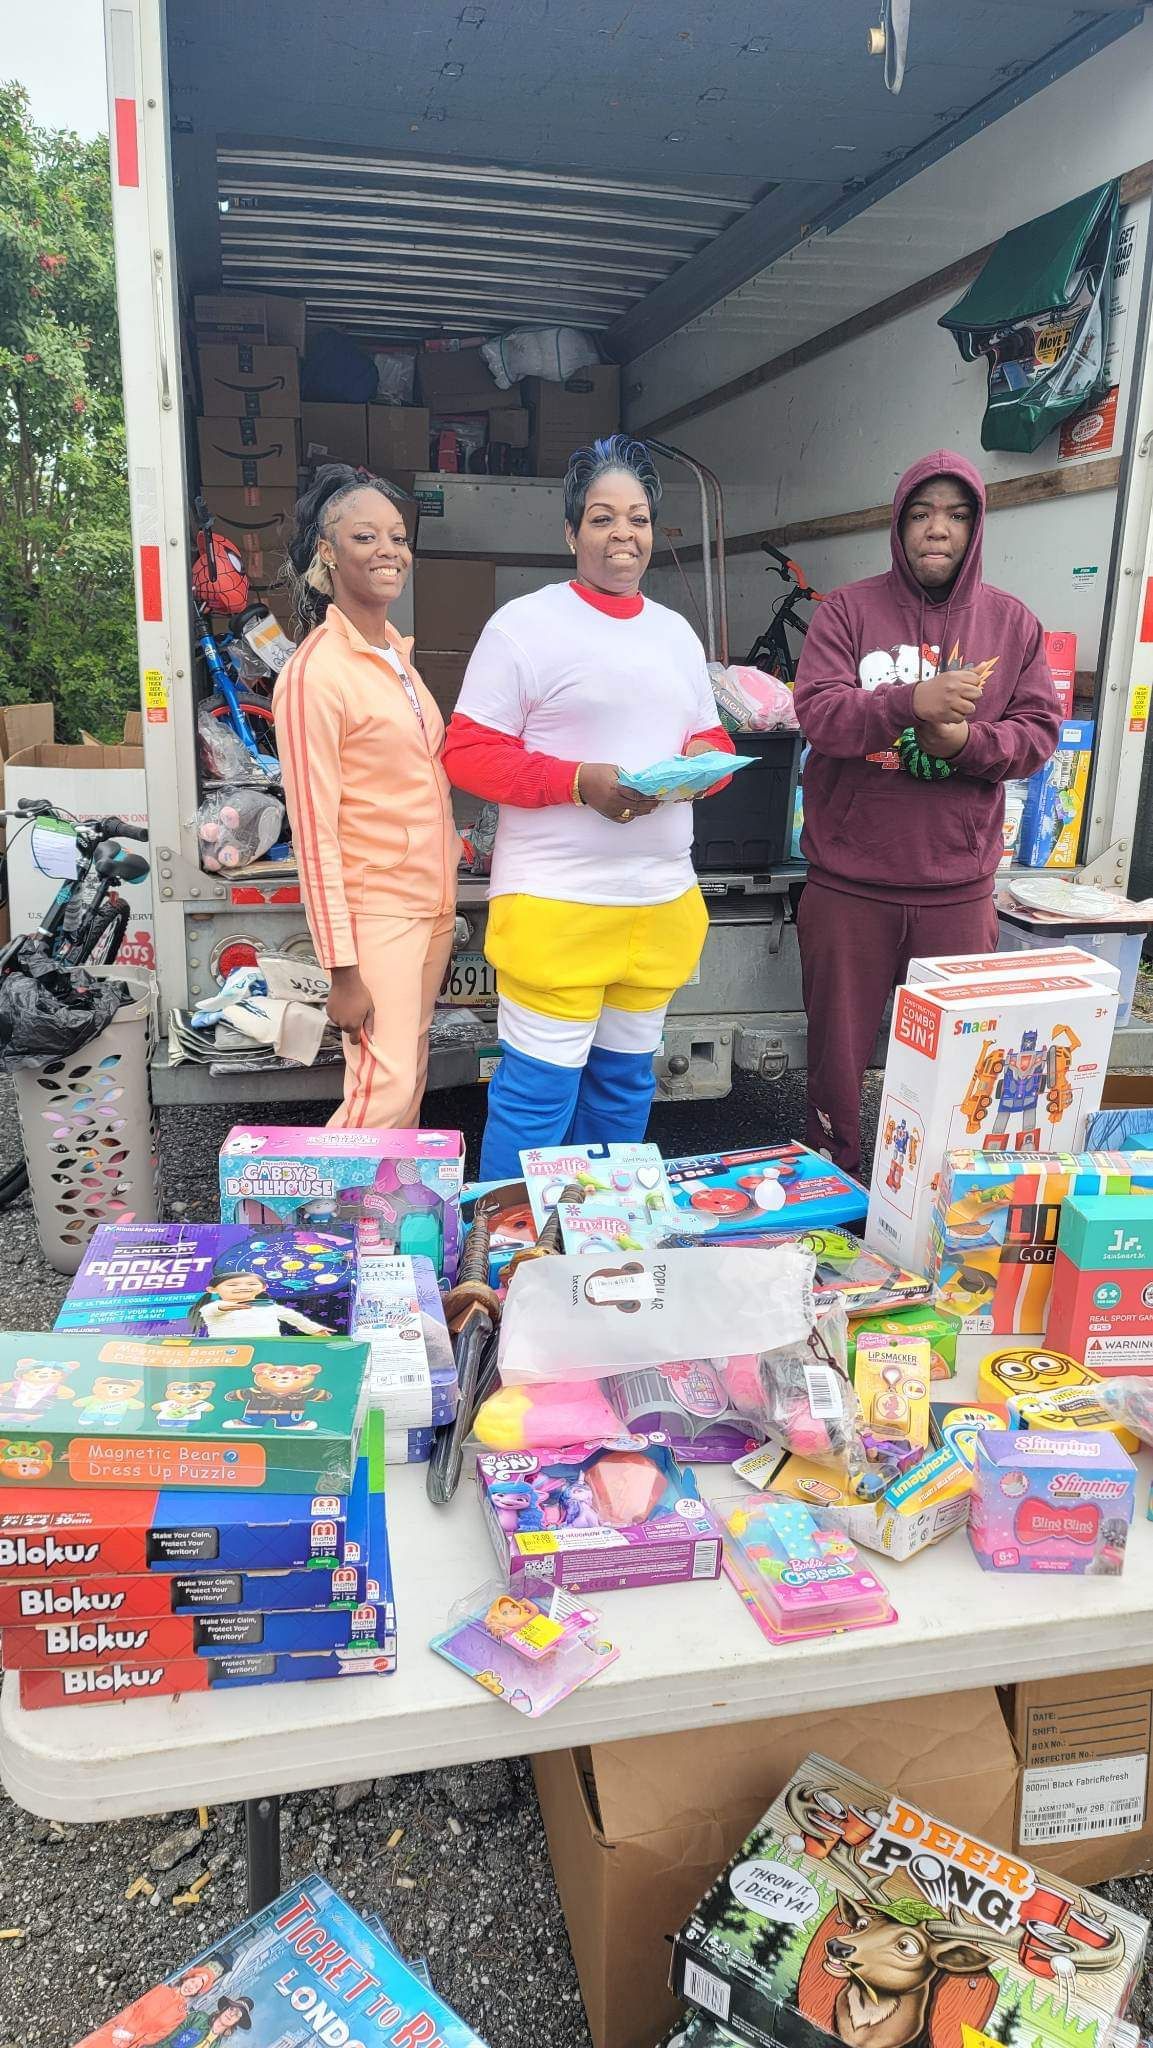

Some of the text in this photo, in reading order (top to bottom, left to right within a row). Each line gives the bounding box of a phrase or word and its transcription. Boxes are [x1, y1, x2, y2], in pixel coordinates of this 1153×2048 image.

[1119, 226, 1135, 245] GET
[1117, 243, 1133, 262] OAD
[1113, 260, 1130, 279] OW!
[1039, 335, 1062, 350] MOVE
[720, 695, 748, 719] NIGHT
[130, 814, 148, 822] ONL
[121, 945, 149, 961] OTS
[902, 1005, 936, 1031] COMBO
[1094, 1008, 1109, 1018] 3+
[900, 1018, 935, 1052] 5IN1
[953, 1019, 998, 1035] Snaen
[244, 1165, 318, 1182] GABBY'S
[227, 1180, 334, 1197] DOLLHOUSE
[1107, 1230, 1142, 1251] Jr.
[113, 1246, 196, 1255] PLANETARY
[1019, 1247, 1055, 1262] GOE
[85, 1257, 212, 1276] ROCKET
[104, 1273, 188, 1291] TOSS
[86, 1299, 123, 1307] ULTIMATE
[154, 1294, 197, 1302] ADVENTURE
[1097, 1288, 1118, 1300] 6+
[1111, 1314, 1137, 1322] SPORT
[113, 1353, 159, 1363] Dress
[190, 1356, 234, 1365] Puzzle
[117, 1344, 226, 1357] Magnetic Bear
[881, 1352, 918, 1363] SMACKER
[88, 1445, 220, 1462] Magnetic Bear
[1015, 1437, 1099, 1455] Shinning
[88, 1463, 237, 1481] Dress Up Puzzle
[481, 1456, 537, 1480] PONY
[1049, 1475, 1129, 1496] Shinning
[2, 1517, 93, 1527] 7+ 2-4 30min
[1032, 1517, 1094, 1533] Bling Bling
[0, 1537, 99, 1568] Blokus
[166, 1548, 199, 1556] Territory!
[789, 1559, 827, 1572] Barbie
[785, 1565, 849, 1585] Chelsea
[21, 1587, 124, 1617] Blokus
[207, 1625, 233, 1633] Protect
[212, 1633, 244, 1641] Territory!
[46, 1624, 148, 1655] Blokus
[64, 1665, 164, 1695] Blokus
[221, 1659, 247, 1667] Protect
[226, 1666, 258, 1674] Territory!
[1033, 1712, 1056, 1721] DATE:
[1032, 1727, 1058, 1736] SHIFT:
[1031, 1742, 1049, 1751] BOX
[1031, 1752, 1076, 1765] INSPECTOR
[1025, 1772, 1129, 1792] 800ml Black FabricRefresh
[886, 1803, 1029, 1894] DEER
[749, 1867, 812, 1898] THROW IT,
[867, 1836, 1013, 1927] PONG
[735, 1879, 814, 1913] I DEER YA!
[274, 1893, 382, 2002] TICKET
[365, 1992, 402, 2028] TO
